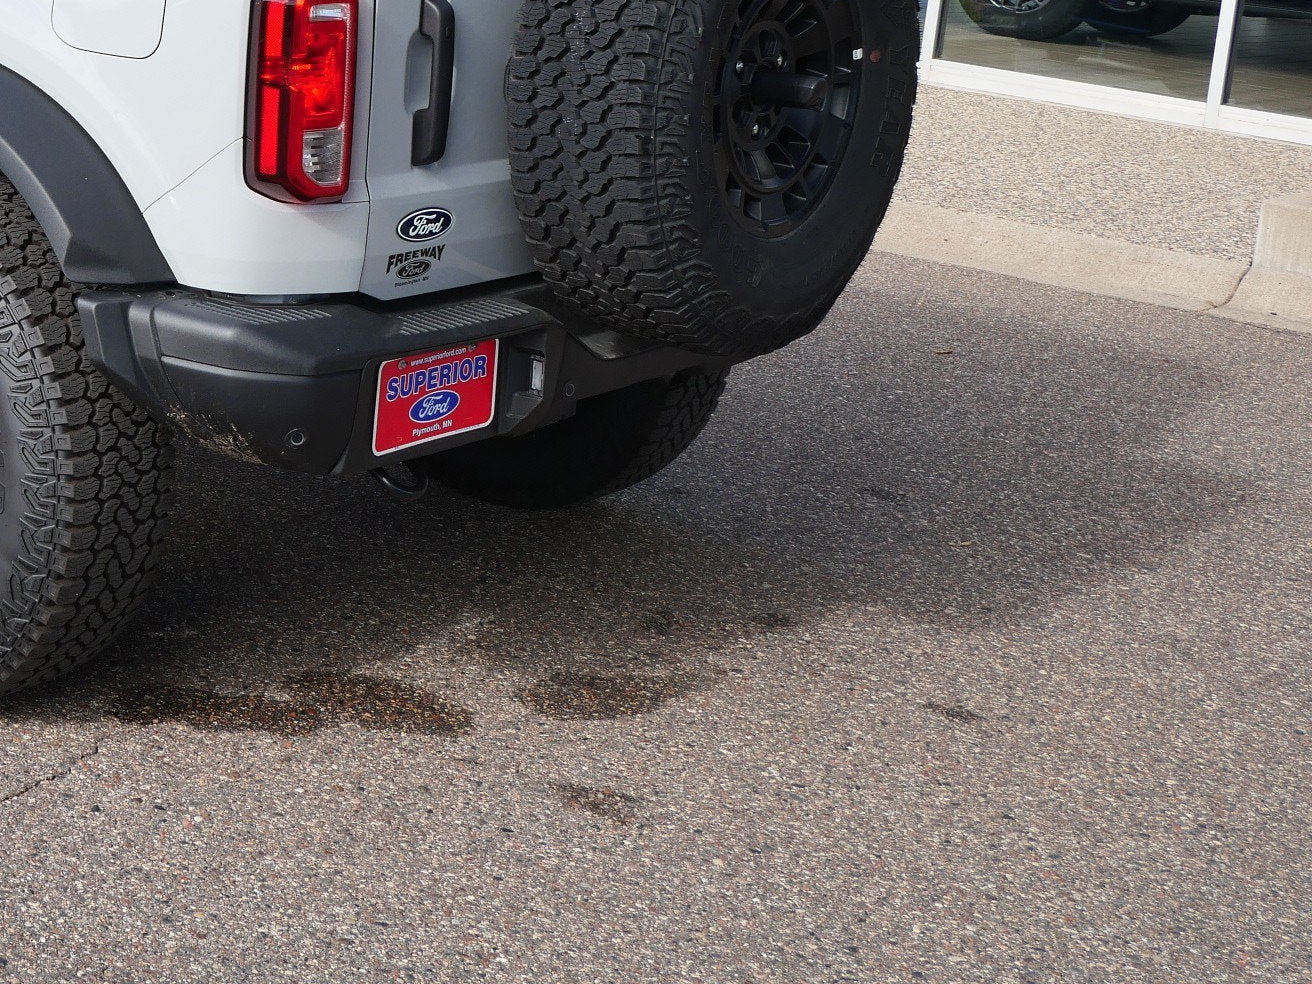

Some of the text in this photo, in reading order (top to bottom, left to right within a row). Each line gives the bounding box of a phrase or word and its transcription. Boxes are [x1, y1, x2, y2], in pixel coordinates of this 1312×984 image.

[385, 243, 446, 275] FREEWAY
[410, 346, 467, 367] www.superiorford.com
[385, 354, 488, 402] SUPERIOR
[418, 394, 451, 419] Ford
[412, 419, 453, 437] Plymouth, MN
